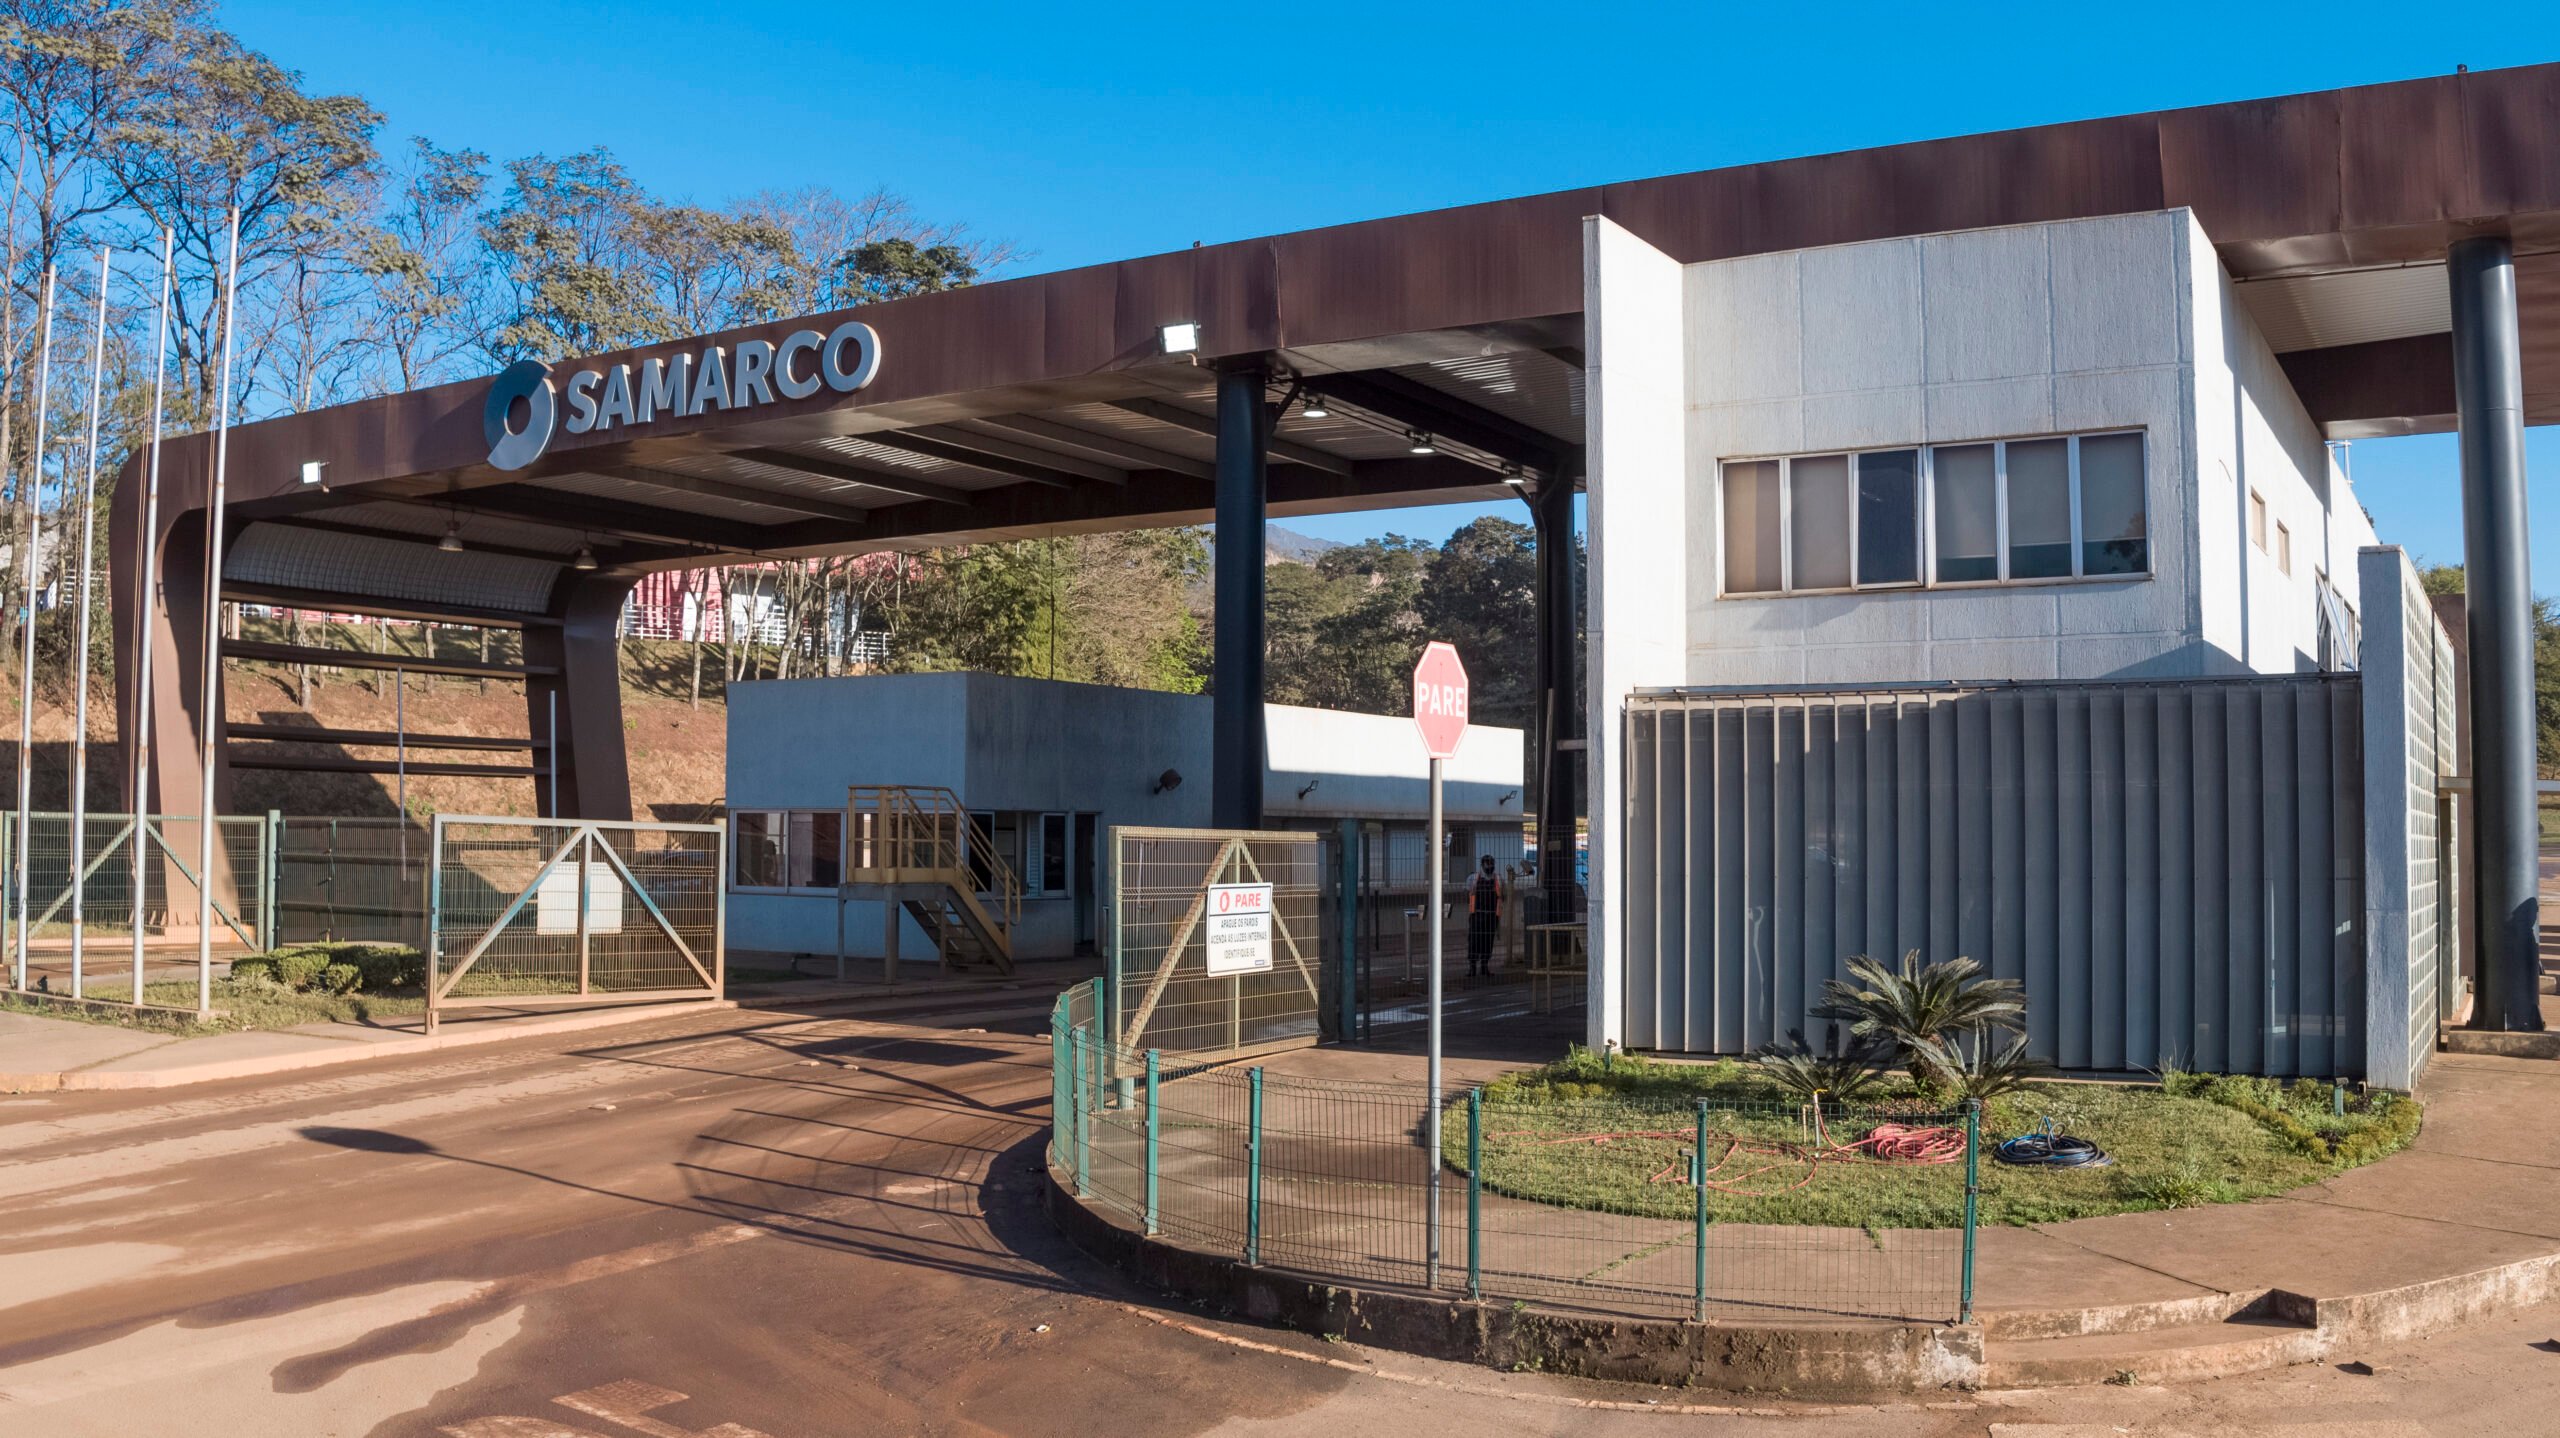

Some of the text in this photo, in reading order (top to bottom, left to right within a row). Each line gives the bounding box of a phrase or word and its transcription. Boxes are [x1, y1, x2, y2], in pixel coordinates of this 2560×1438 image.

[565, 321, 882, 434] SAMARCO
[1418, 681, 1465, 718] PARE
[1234, 892, 1261, 907] PARE
